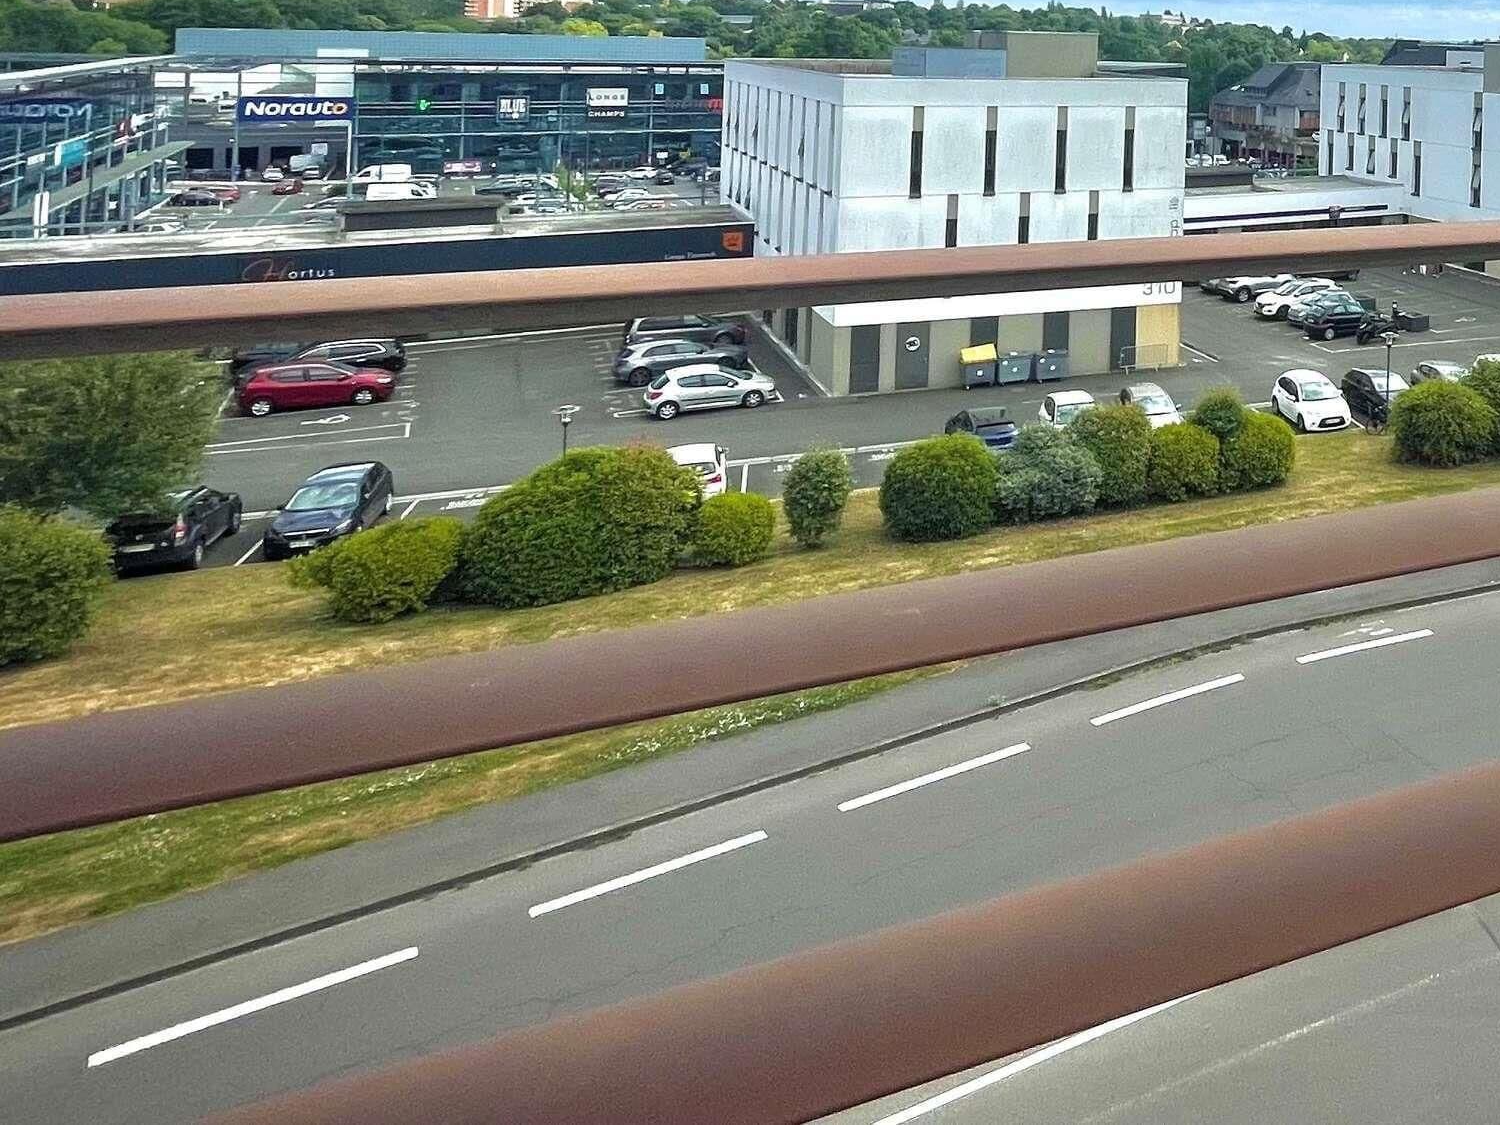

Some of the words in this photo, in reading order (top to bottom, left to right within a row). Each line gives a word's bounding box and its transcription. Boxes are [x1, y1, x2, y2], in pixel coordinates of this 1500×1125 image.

[244, 101, 348, 116] Norauto
[587, 110, 625, 118] CHAMPS
[1142, 282, 1176, 296] 310
